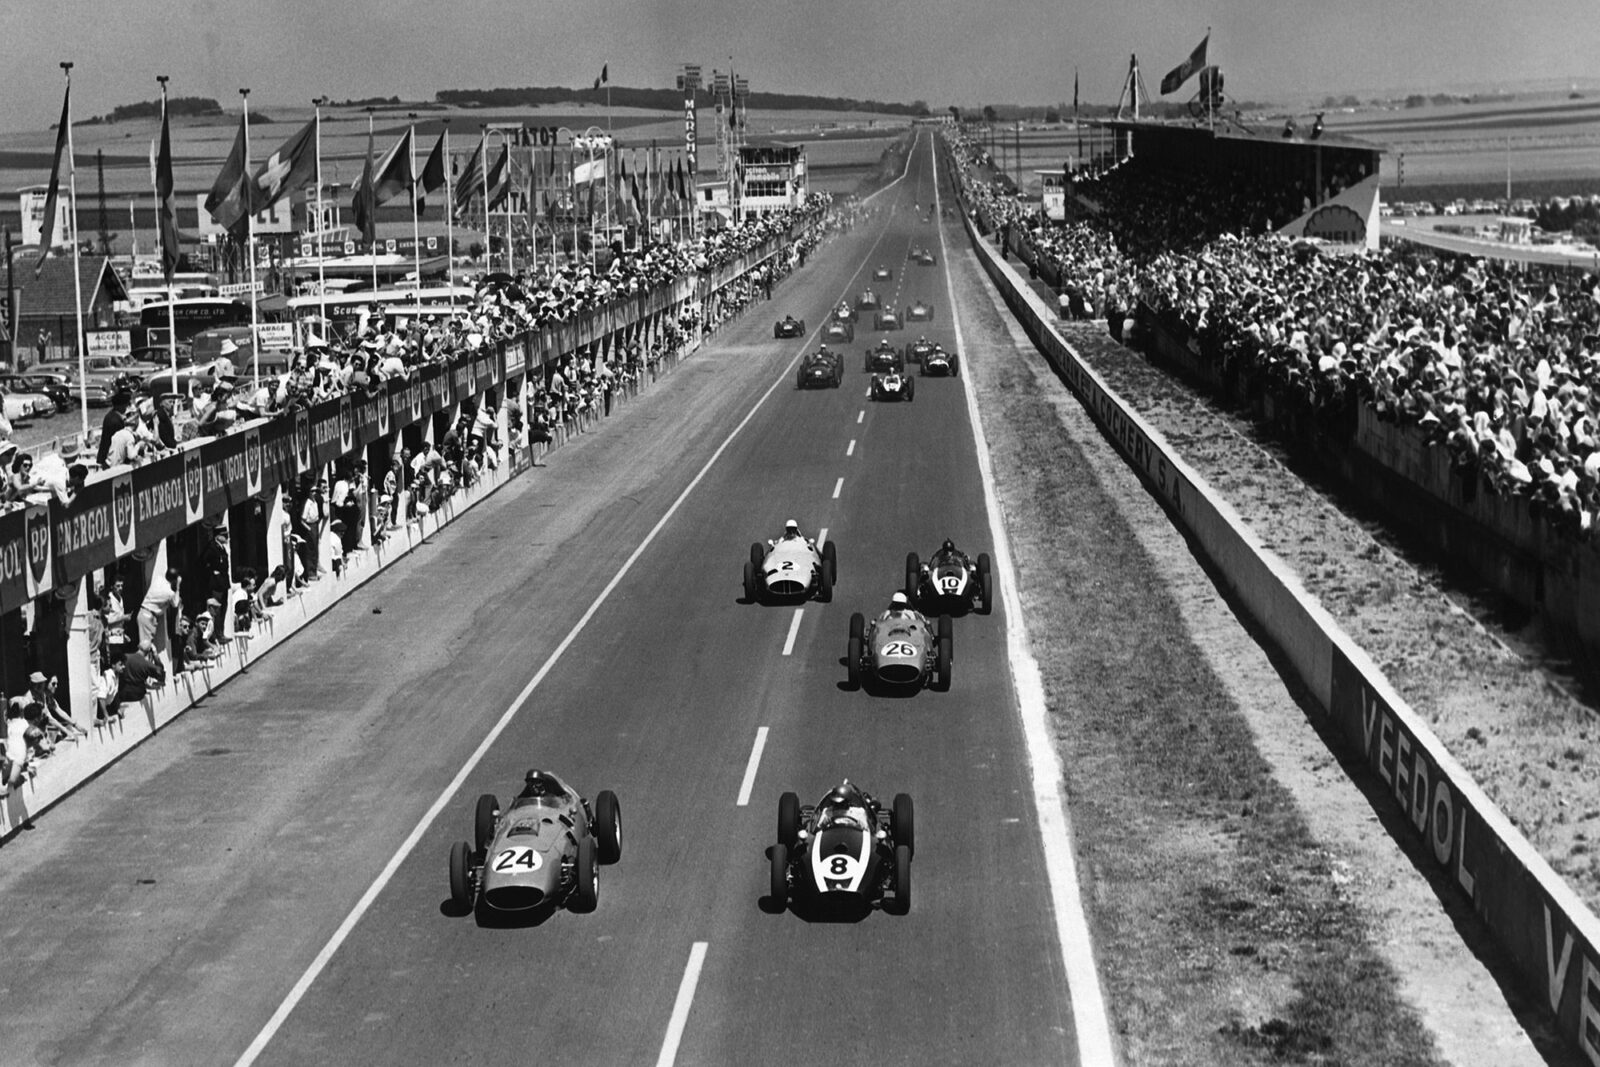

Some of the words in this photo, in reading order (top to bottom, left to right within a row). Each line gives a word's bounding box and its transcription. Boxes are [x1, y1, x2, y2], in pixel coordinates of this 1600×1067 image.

[684, 99, 696, 174] MARCHA
[1101, 396, 1153, 473] COCHERY
[138, 477, 184, 522] ENERGOL
[188, 468, 201, 498] BP
[117, 494, 133, 529] BP
[31, 526, 48, 565] BP
[57, 505, 110, 557] ENERGOL
[782, 561, 794, 571] 2
[942, 578, 959, 588] 10
[886, 643, 914, 656] 26
[1361, 684, 1476, 899] VEEDOL
[495, 849, 536, 872] 24
[830, 857, 847, 876] 8
